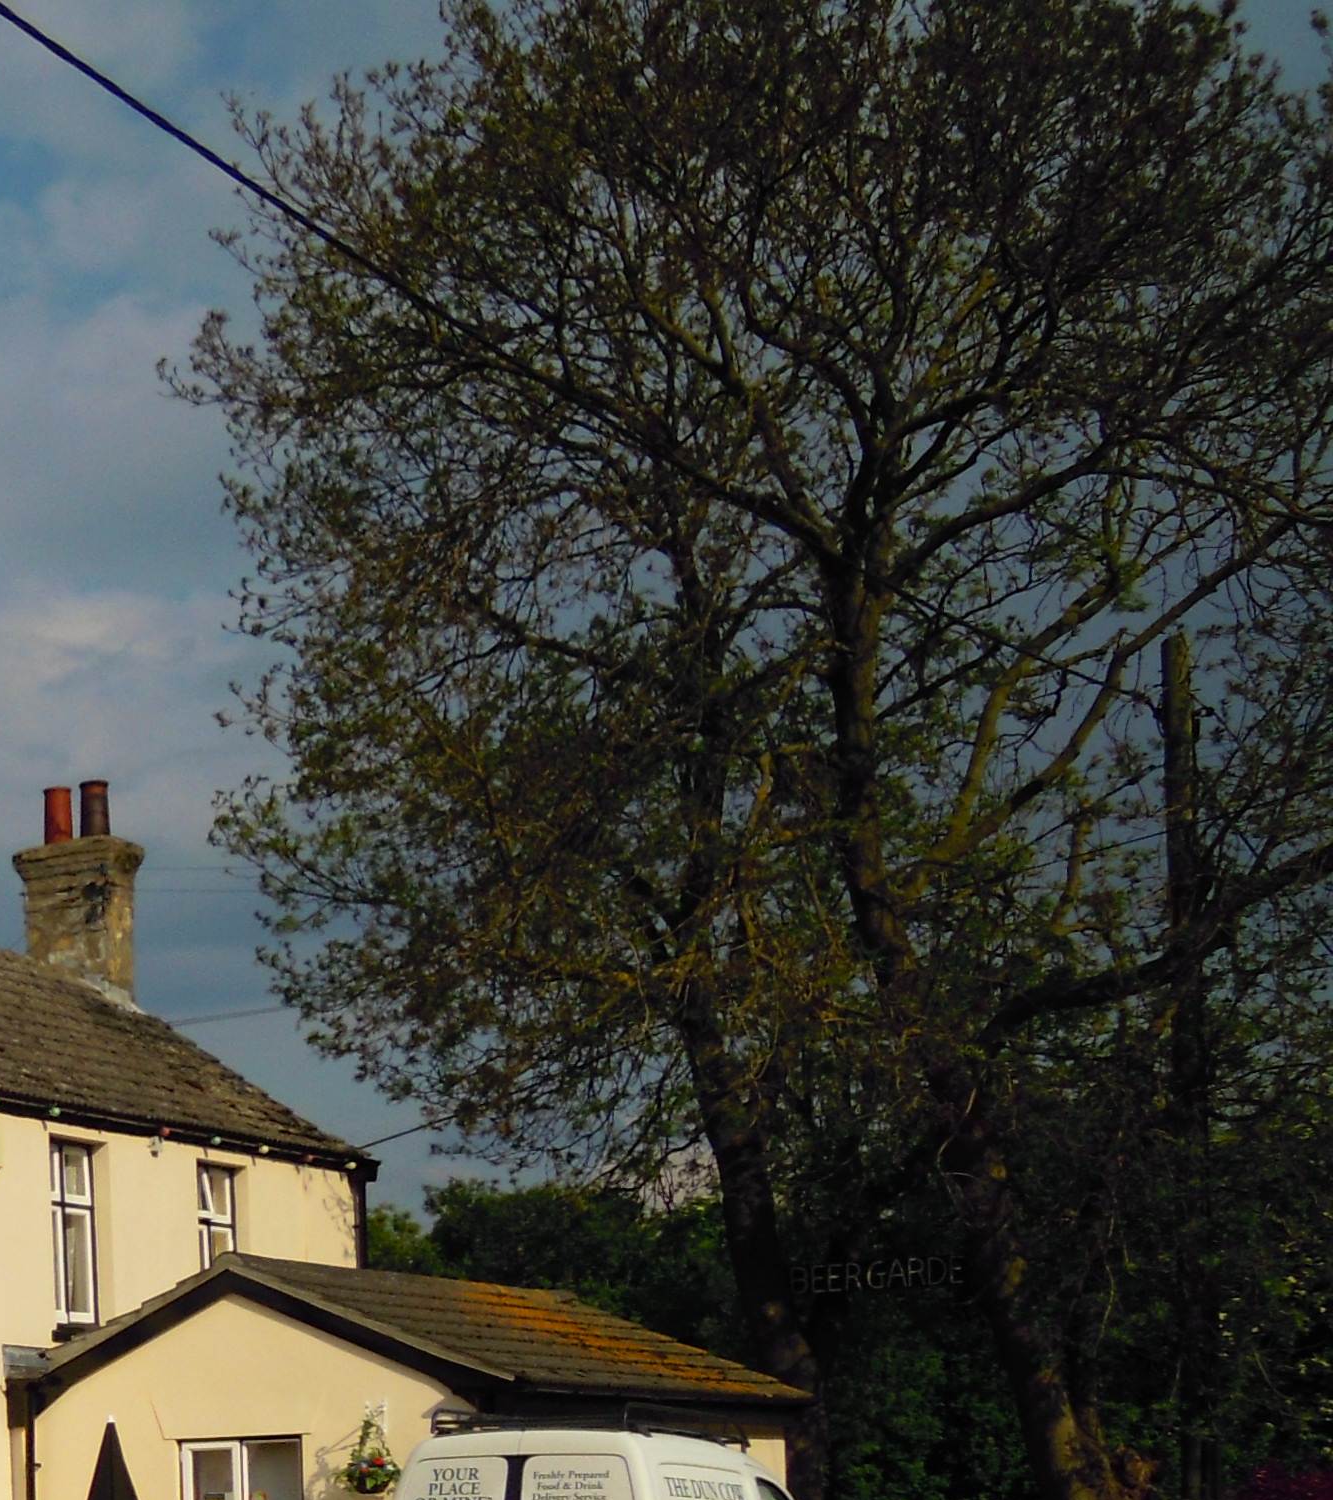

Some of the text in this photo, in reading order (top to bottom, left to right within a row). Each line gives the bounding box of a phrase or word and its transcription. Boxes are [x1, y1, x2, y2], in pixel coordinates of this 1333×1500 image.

[789, 1262, 863, 1295] BEER
[433, 1468, 479, 1481] YOUR
[533, 1469, 610, 1481] Freshly Prepared
[429, 1482, 481, 1495] PLACE
[537, 1481, 603, 1490] Food & Drink
[664, 1476, 692, 1498] THE
[690, 1479, 718, 1500] DUN
[573, 1493, 607, 1500] Service
